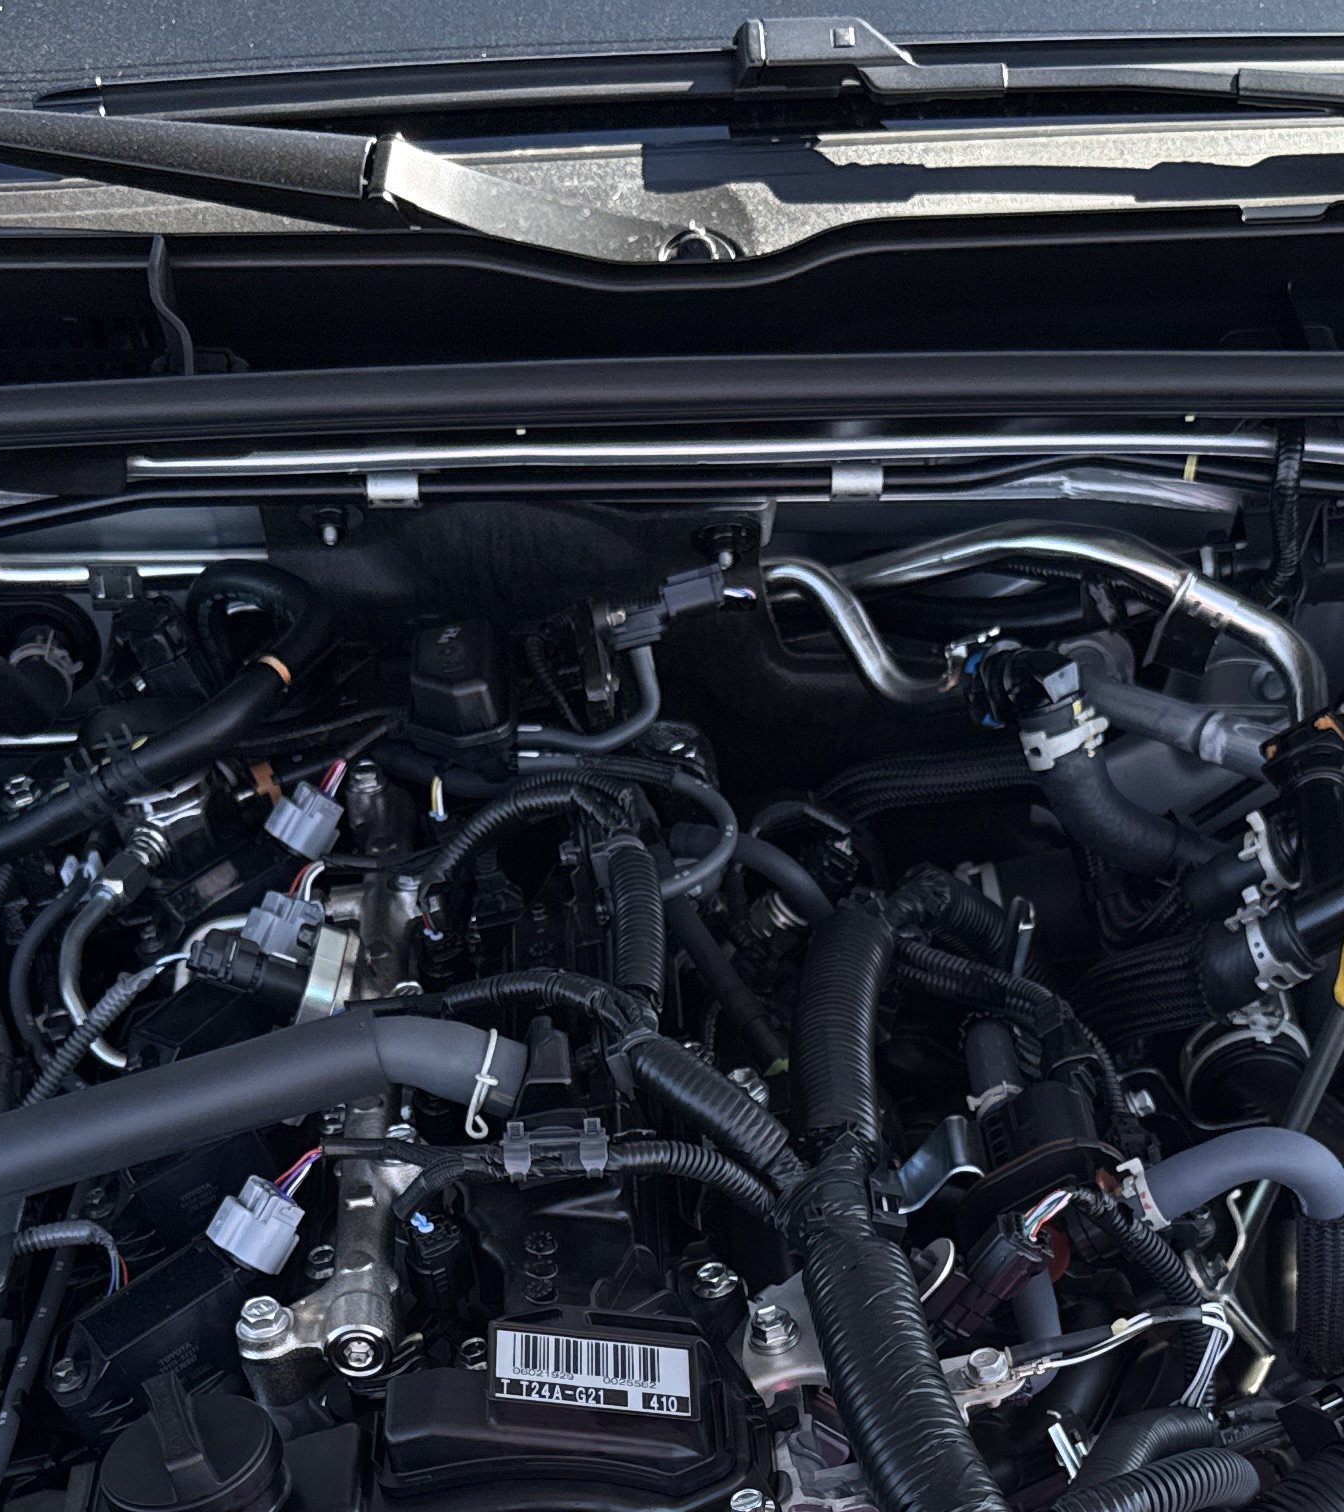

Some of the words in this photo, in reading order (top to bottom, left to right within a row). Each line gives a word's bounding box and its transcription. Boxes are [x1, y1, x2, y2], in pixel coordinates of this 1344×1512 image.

[158, 1342, 193, 1366] TOYOTA
[500, 1378, 511, 1395] T
[519, 1380, 605, 1405] T24A-G21
[649, 1395, 679, 1412] 410
